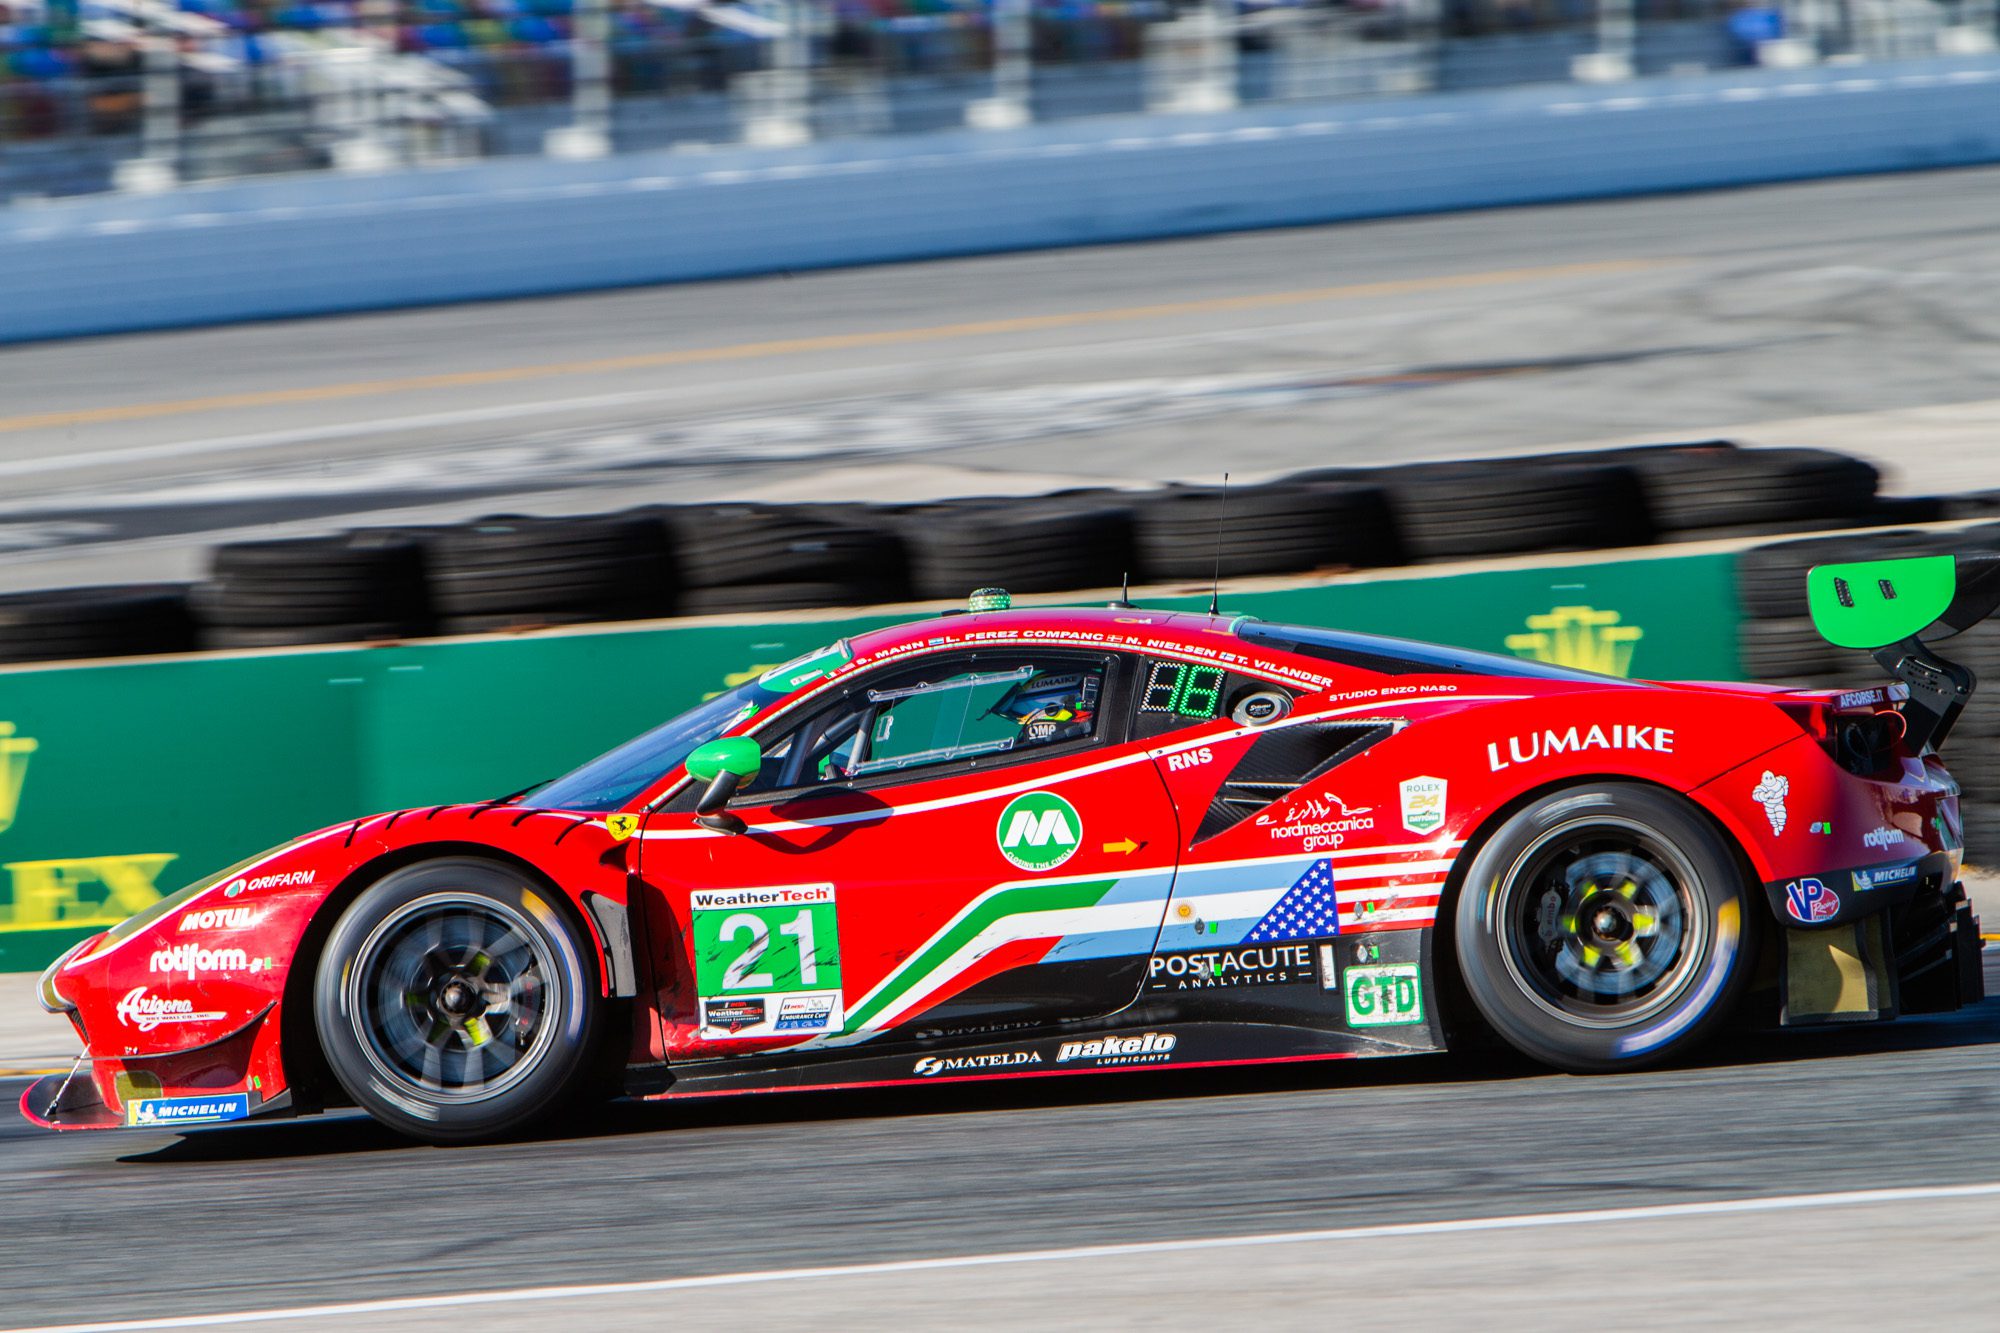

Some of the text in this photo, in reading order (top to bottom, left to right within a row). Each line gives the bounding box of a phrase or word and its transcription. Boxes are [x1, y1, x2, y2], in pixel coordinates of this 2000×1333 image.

[944, 630, 1104, 643] L. PEREZ COMPANC
[1125, 635, 1217, 659] N. NIELSEN
[856, 641, 923, 665] S. MANN
[1234, 654, 1333, 687] T. VILANDER
[1329, 684, 1457, 702] STUDIO ENZO NASO
[1840, 687, 1884, 708] AFCORSE.IT
[1487, 724, 1675, 772] LUMAIKE
[1168, 748, 1213, 772] RNS
[1406, 784, 1440, 792] ROLEX
[1409, 794, 1439, 809] 24
[1271, 816, 1374, 839] nordmeccanica
[1864, 826, 1904, 851] rotiform
[1303, 833, 1344, 852] group
[248, 870, 316, 891] ORIFARM
[1874, 866, 1916, 882] MICHELIN
[1786, 878, 1825, 921] VP
[179, 907, 254, 932] MOTUL
[719, 909, 818, 990] 21
[150, 942, 247, 981] rotiform
[1150, 945, 1311, 978] POSTACUTE
[1179, 972, 1287, 989] ANALYTICS
[1351, 972, 1416, 1016] GTD
[781, 1013, 813, 1021] ENDURANCE
[1056, 1033, 1177, 1062] pakelo
[1097, 1053, 1171, 1065] LUBRICANTS
[946, 1051, 1043, 1070] MATELDA
[158, 1102, 237, 1118] MICHELIN
